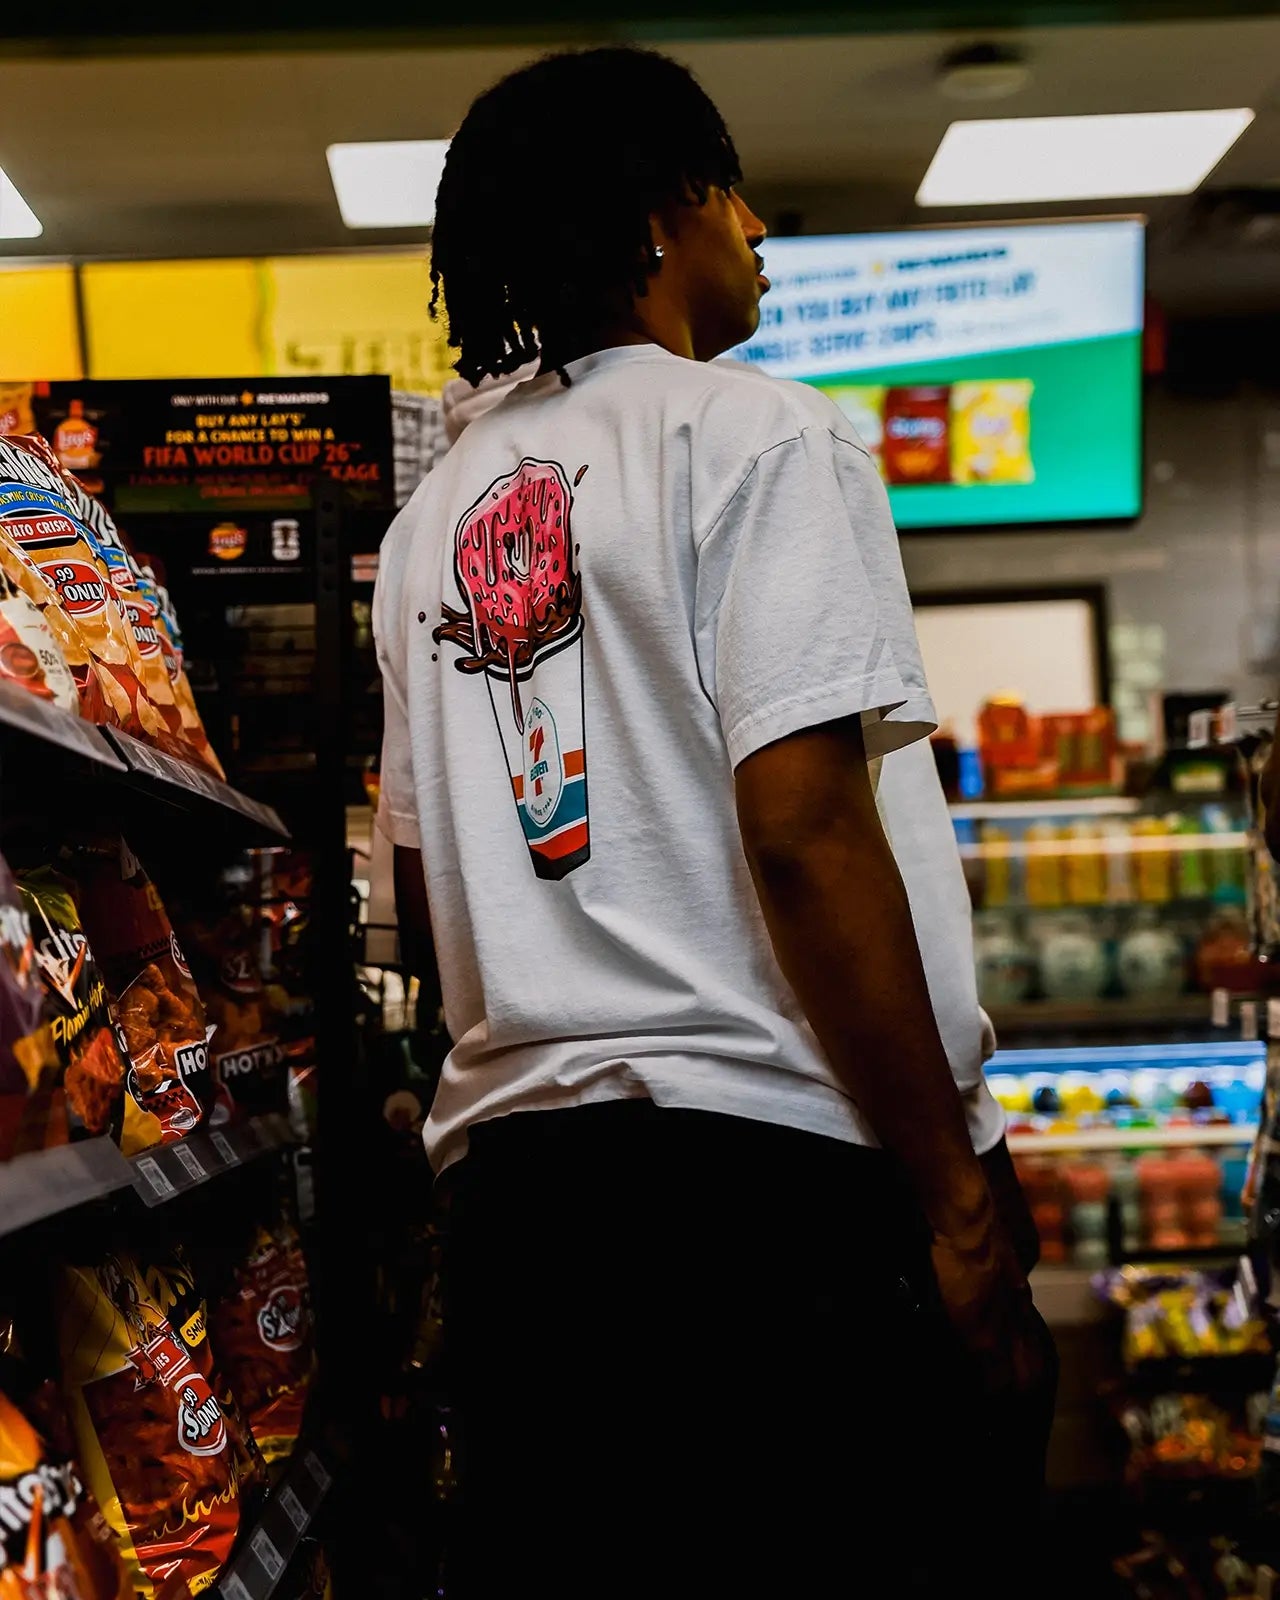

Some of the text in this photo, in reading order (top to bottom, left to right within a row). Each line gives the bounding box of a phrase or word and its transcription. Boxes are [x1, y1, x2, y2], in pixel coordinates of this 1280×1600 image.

[195, 414, 225, 428] BUY
[229, 413, 258, 427] ANY
[165, 426, 335, 444] FOR A CHANCE TO WIN A
[143, 445, 187, 467] FIFA
[193, 444, 274, 466] WORLD
[278, 442, 320, 465] CUP
[4, 520, 72, 538] TATO CRISPS
[186, 1316, 206, 1341] SMO
